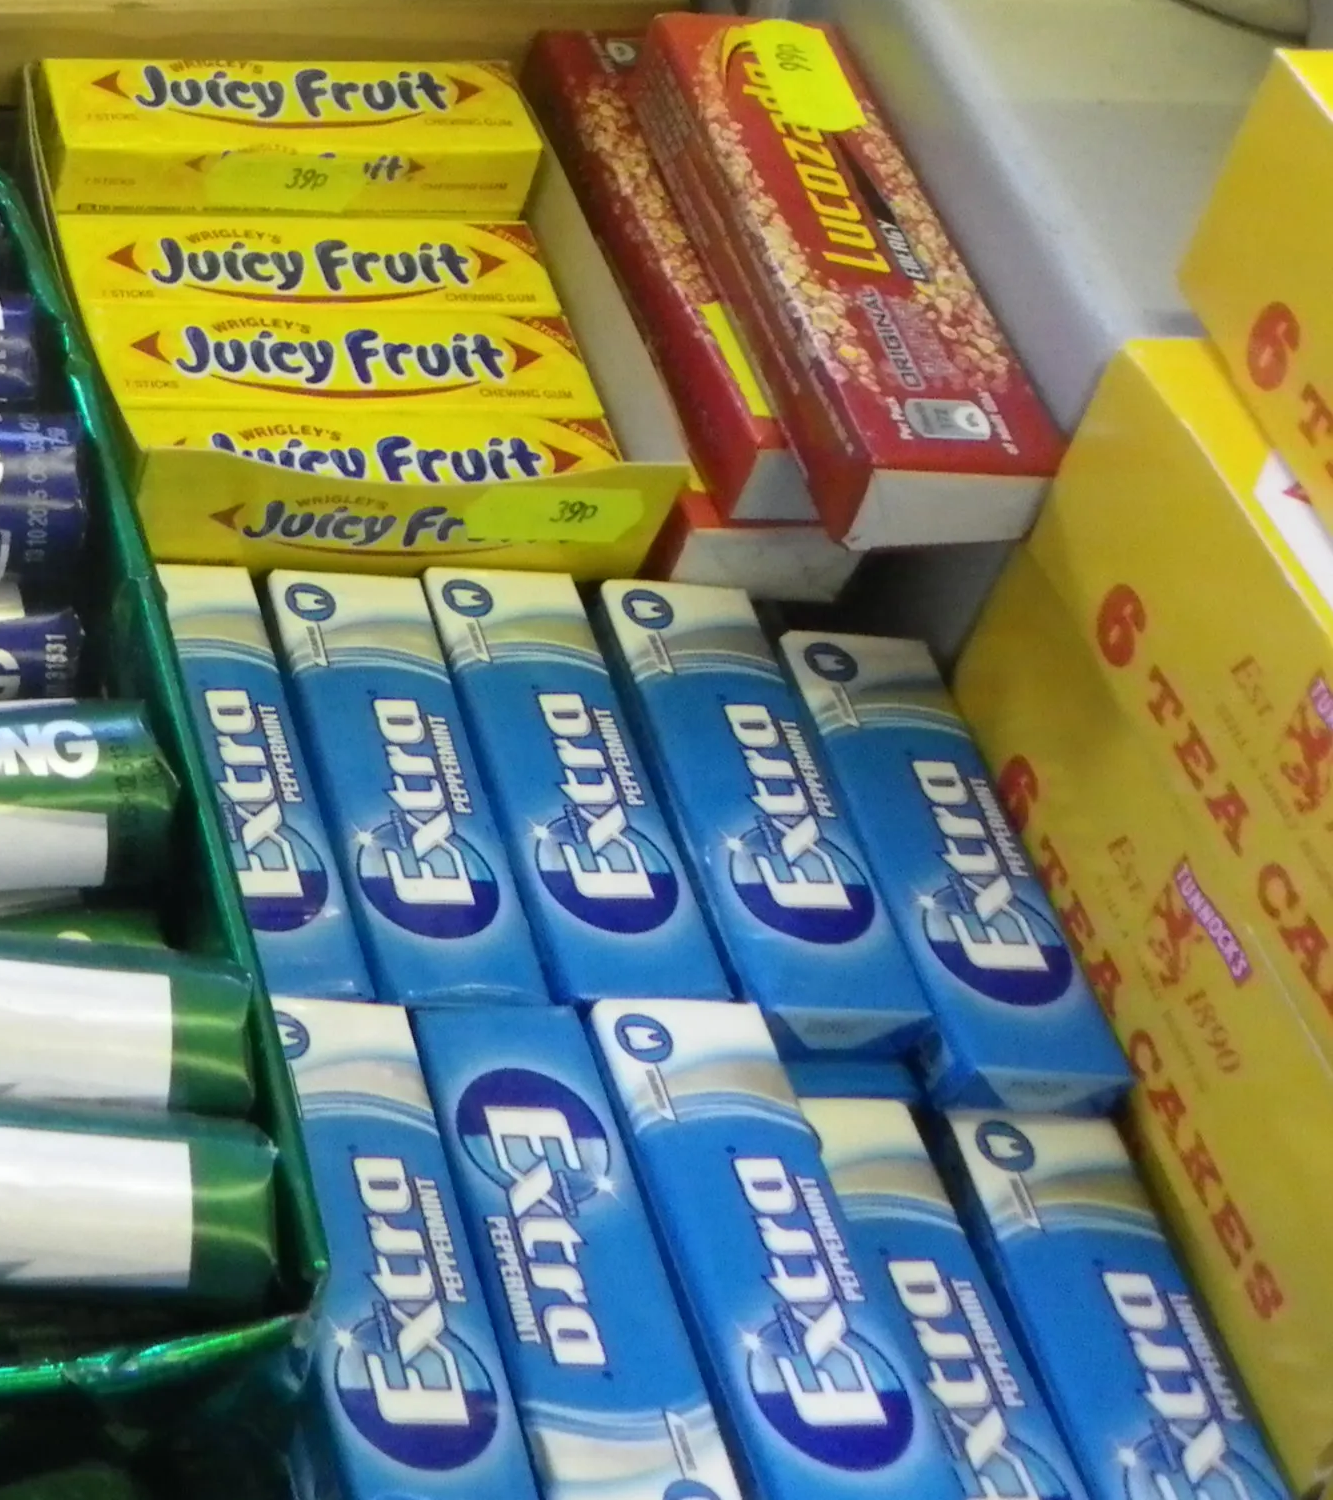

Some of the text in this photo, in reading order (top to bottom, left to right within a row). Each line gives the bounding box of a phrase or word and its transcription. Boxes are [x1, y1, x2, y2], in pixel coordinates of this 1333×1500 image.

[135, 65, 449, 119] Juicy Fruit
[151, 237, 470, 292] Juicy Fruit
[186, 229, 282, 246] WRIGLEY'S
[174, 325, 506, 384] Juicy Fruit
[211, 317, 312, 335] WRIGLEY'S
[239, 424, 343, 442] WRIGLEY'S
[376, 435, 545, 483] Fruit
[243, 500, 398, 546] Juicy
[256, 701, 304, 805] PEPPERMINT
[427, 712, 474, 817] PEPPERMINT
[591, 703, 644, 809] PEPPERMINT
[779, 715, 839, 821] PEPPERMINT
[1096, 582, 1250, 858] 6 TEA
[203, 687, 303, 900] Extra
[371, 698, 474, 907] Extra
[537, 691, 655, 901] Extra
[724, 701, 853, 912] Extra
[970, 775, 1029, 880] PEPPERMINT
[910, 760, 1050, 974] Extra
[1173, 854, 1253, 986] TUNNOCK'S
[412, 1175, 468, 1306] PEPPERMINT
[483, 1105, 607, 1370] Extra
[796, 1176, 868, 1303] PEPPERMINT
[1129, 1028, 1285, 1323] CAKES
[349, 1156, 471, 1428] Extra
[485, 1214, 539, 1345] PEPPERMINT
[731, 1157, 889, 1428] Extra
[951, 1276, 1025, 1410] PEPPERMINT
[1173, 1292, 1244, 1422] PEPPERMINT
